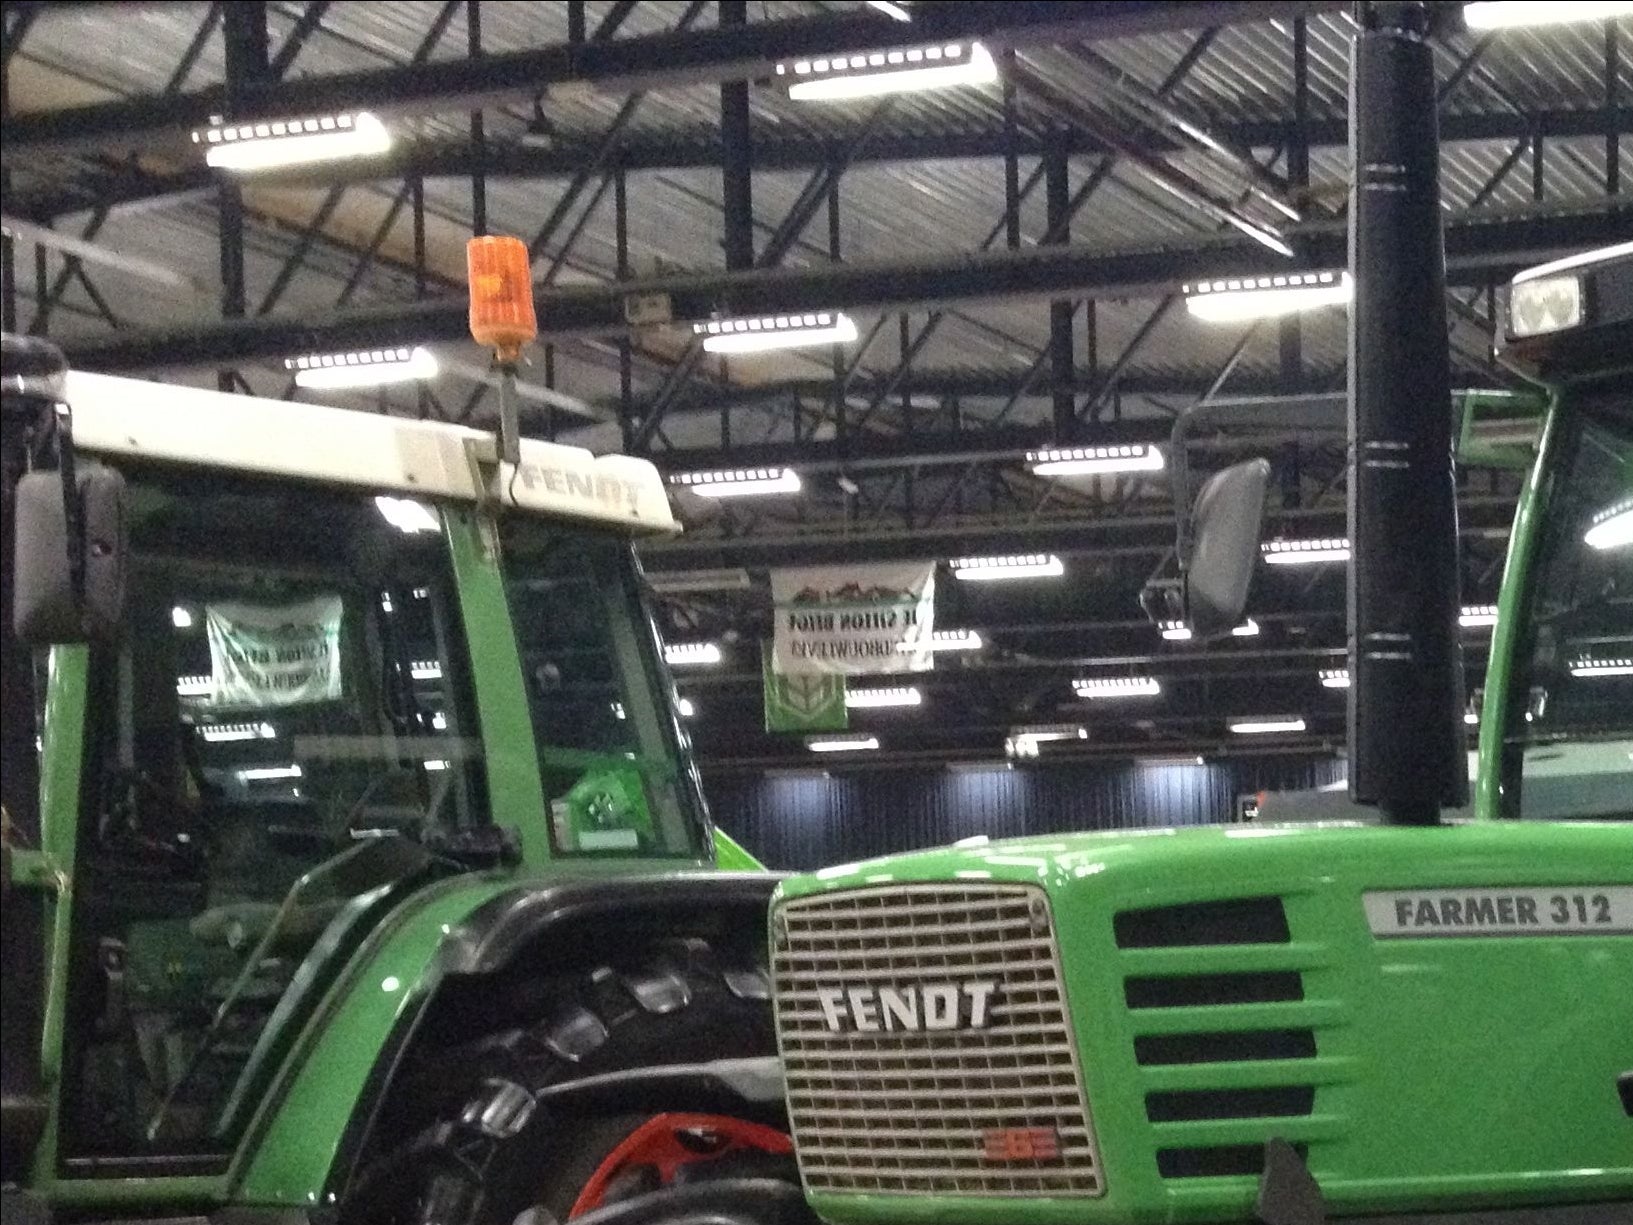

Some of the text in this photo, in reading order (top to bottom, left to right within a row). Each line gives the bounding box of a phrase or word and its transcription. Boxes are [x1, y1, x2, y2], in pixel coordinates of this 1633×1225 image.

[519, 464, 645, 510] FENDT
[1396, 896, 1539, 928] FARMER
[1550, 895, 1612, 924] 312
[817, 981, 995, 1031] FENDT
